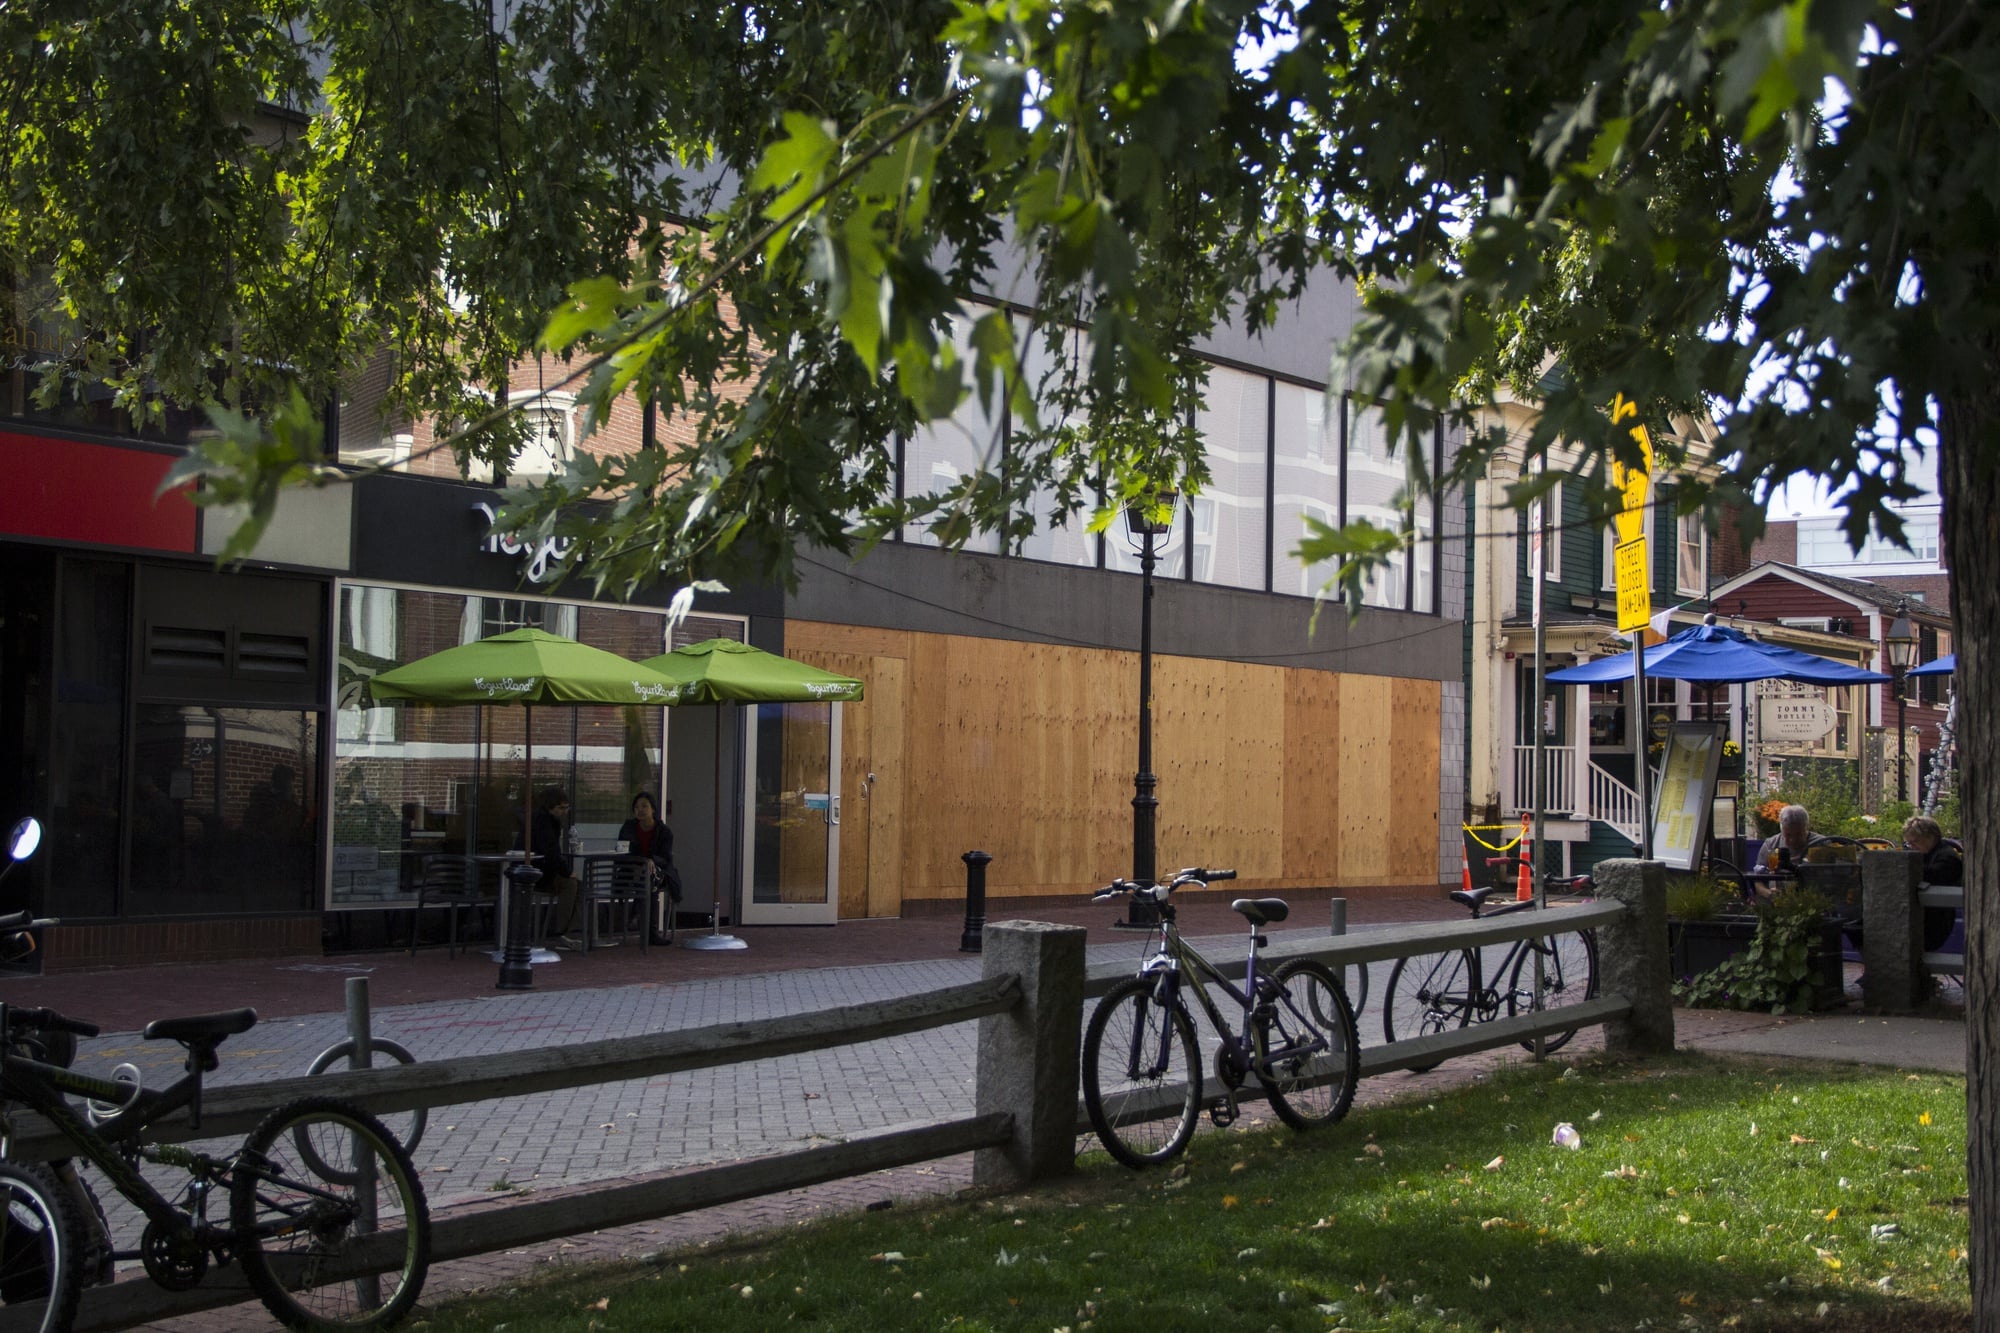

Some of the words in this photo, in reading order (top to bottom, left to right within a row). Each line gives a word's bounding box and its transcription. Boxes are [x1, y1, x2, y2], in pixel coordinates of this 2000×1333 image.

[1620, 544, 1640, 569] STREET
[1621, 568, 1642, 593] CLOSED
[474, 677, 535, 697] Yogurtland
[632, 680, 679, 701] Yogurtland
[803, 682, 857, 699] Yogurtland
